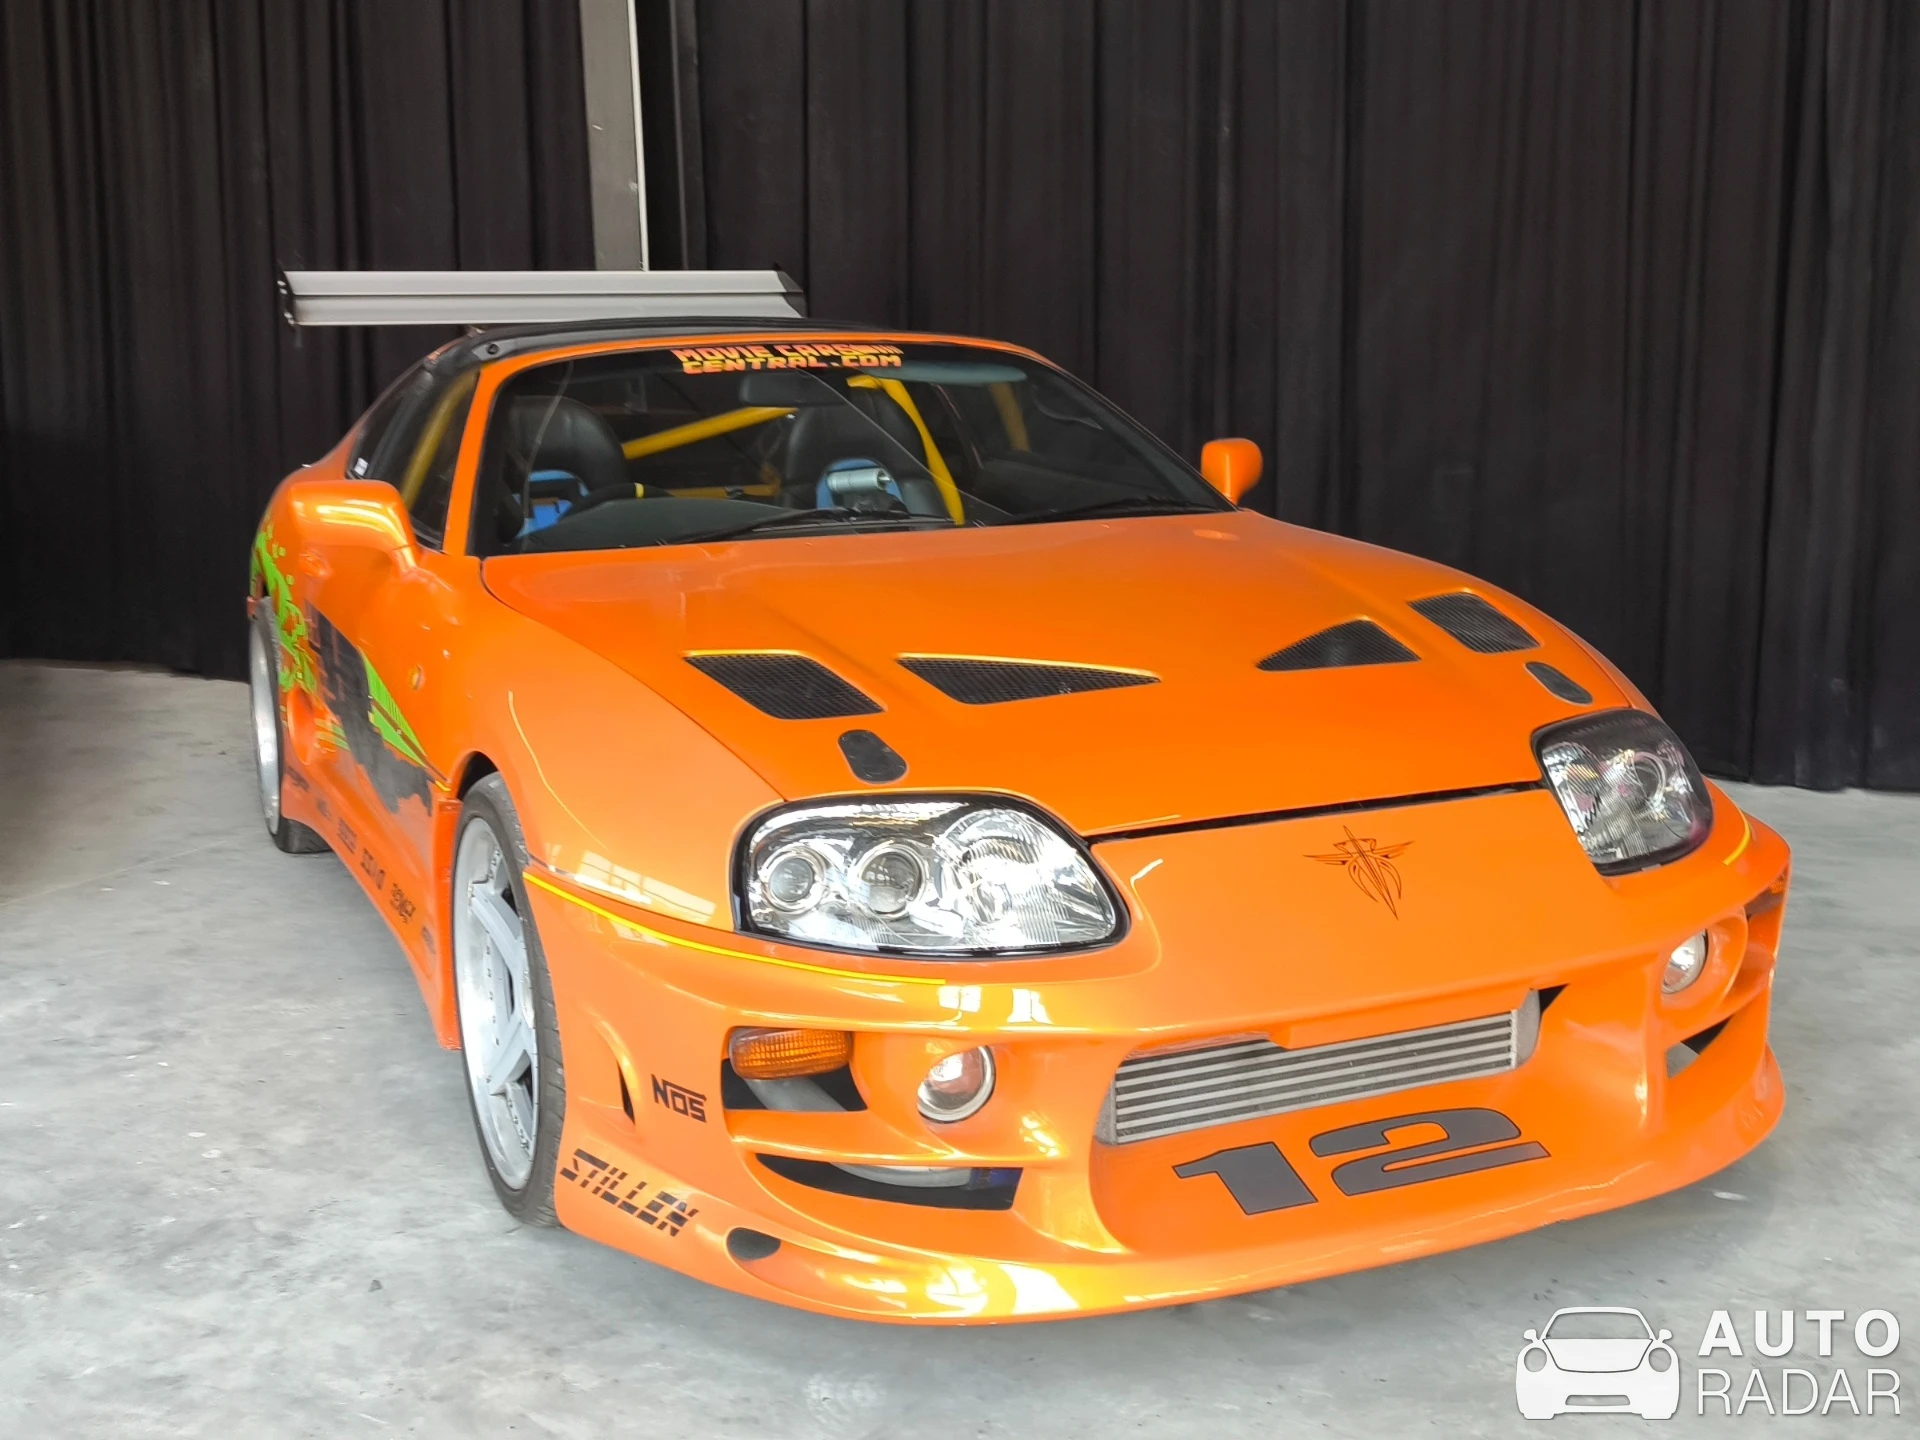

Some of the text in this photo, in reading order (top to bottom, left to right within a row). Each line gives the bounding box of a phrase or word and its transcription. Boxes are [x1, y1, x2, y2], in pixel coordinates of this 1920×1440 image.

[670, 344, 864, 363] MOVIE CARS
[681, 354, 903, 374] CENTRAL.COM
[651, 1073, 707, 1123] NOS
[1172, 1107, 1552, 1215] 12
[560, 1148, 699, 1237] STILLEN
